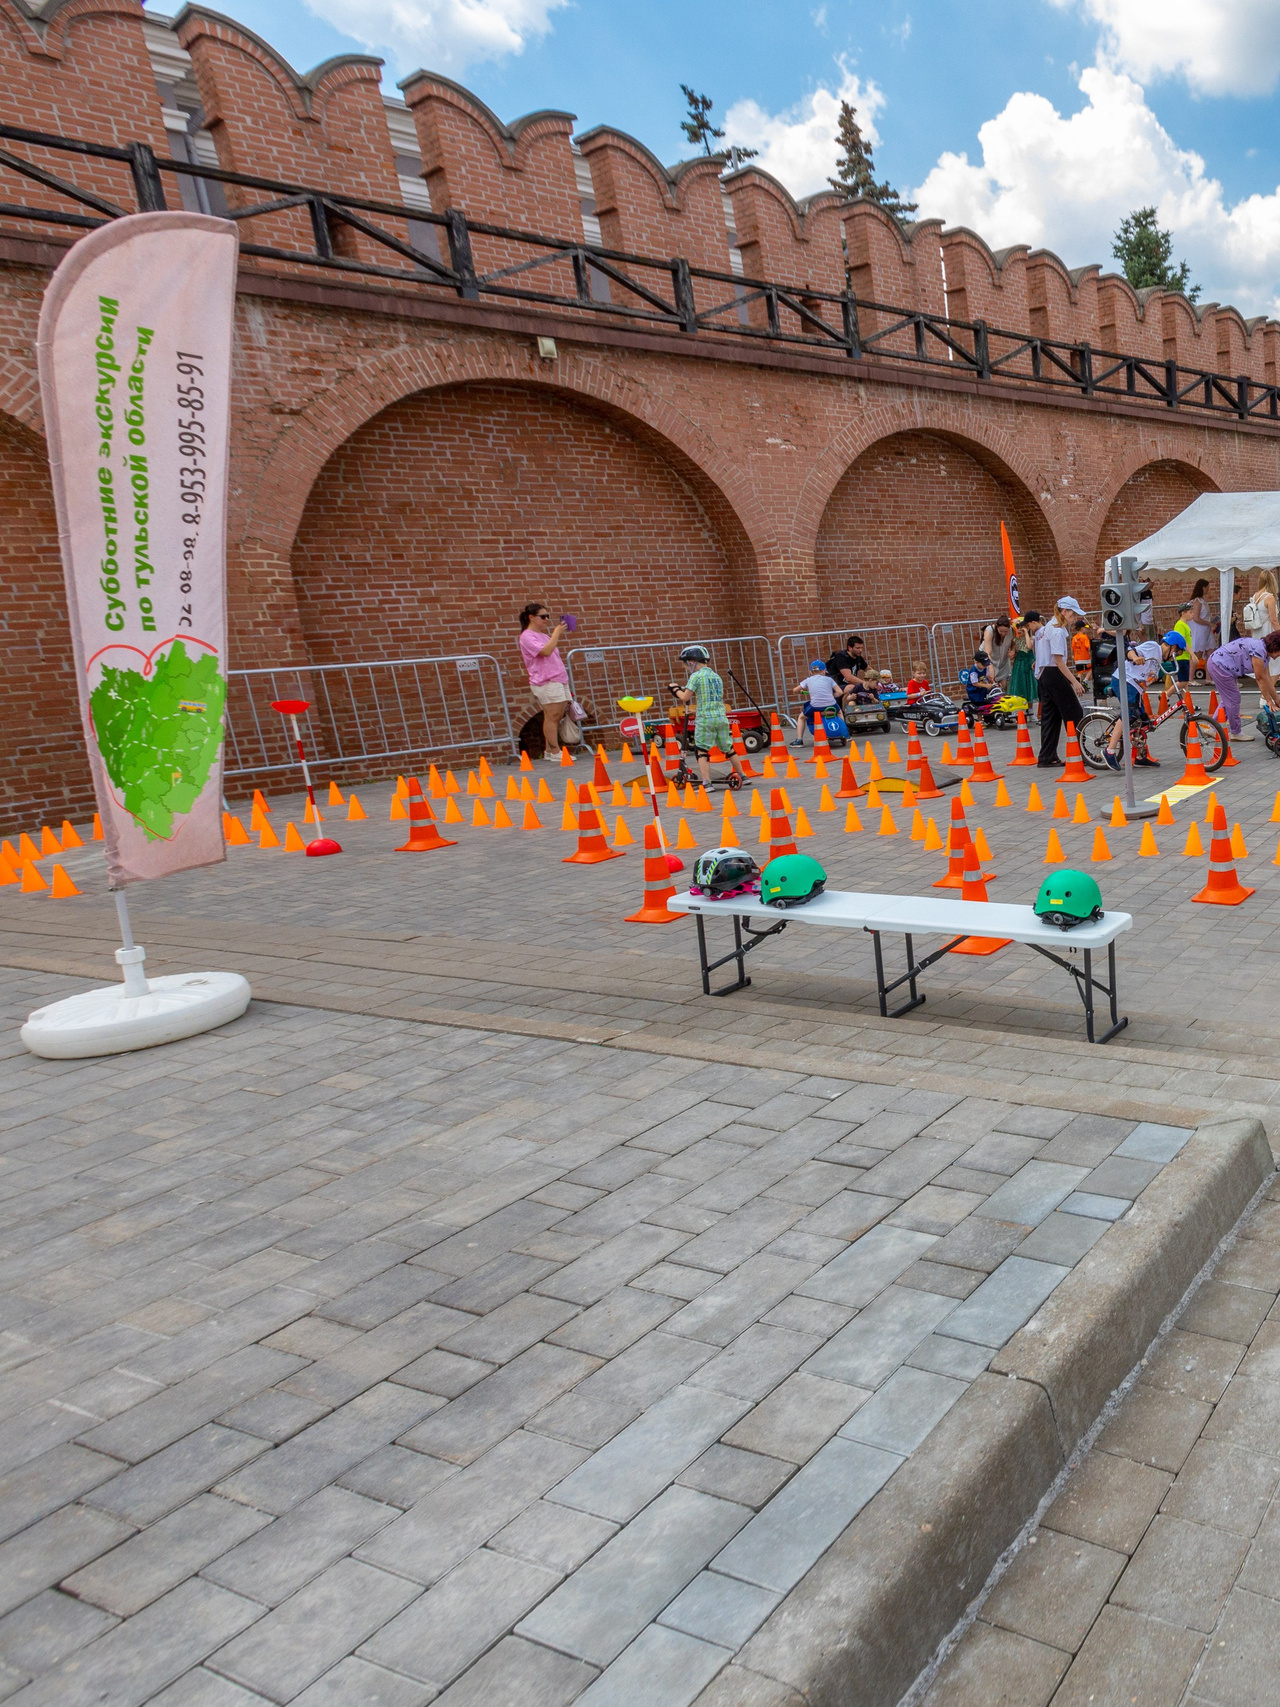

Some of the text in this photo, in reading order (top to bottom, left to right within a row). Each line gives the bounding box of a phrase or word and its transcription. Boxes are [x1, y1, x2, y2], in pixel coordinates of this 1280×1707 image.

[95, 295, 127, 632] Субботние экскурсии
[122, 326, 157, 632] по тульской области
[176, 351, 207, 525] 8-953-995-85-91
